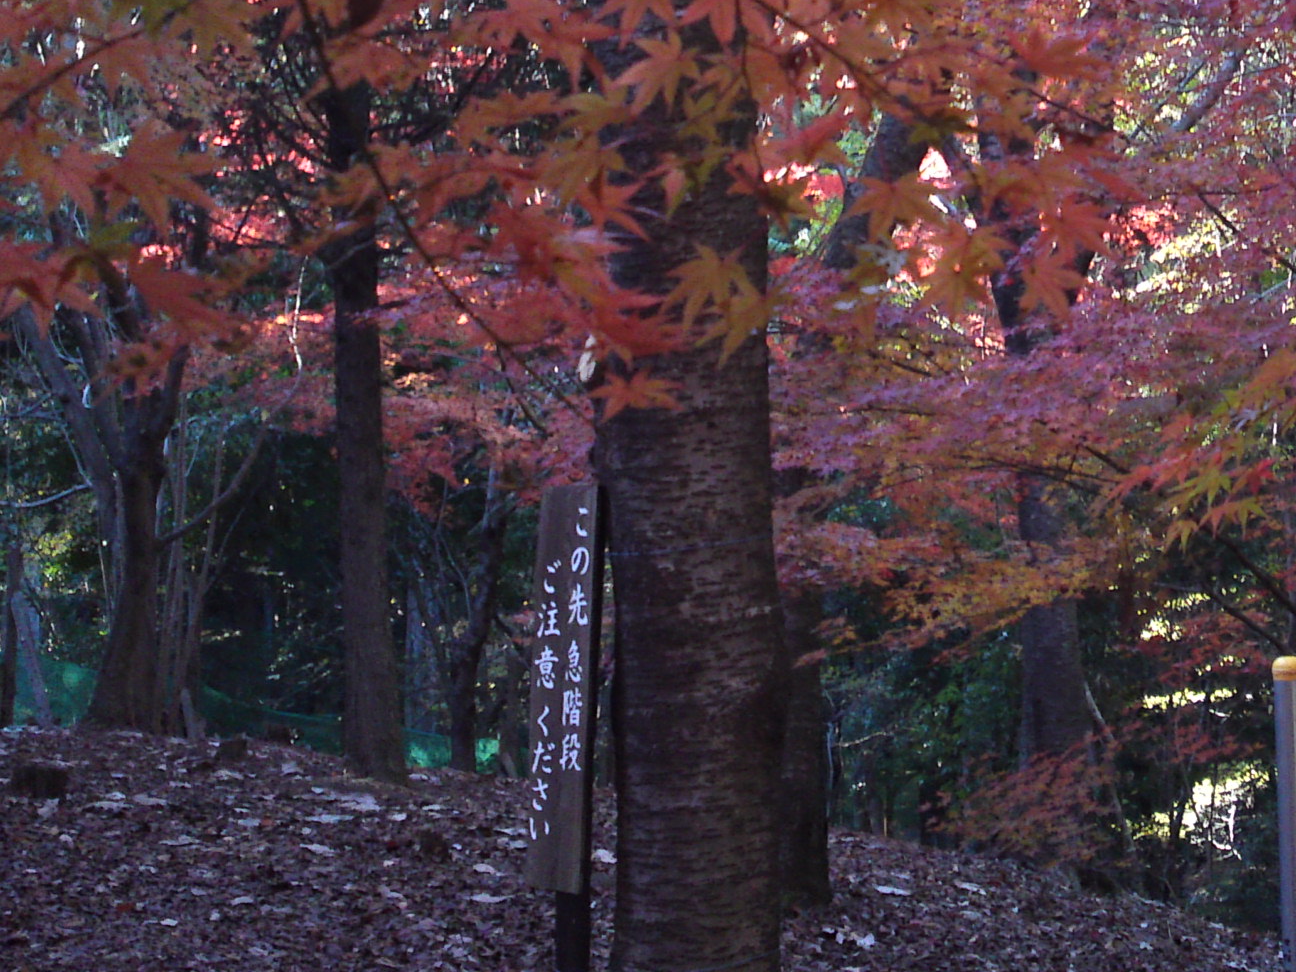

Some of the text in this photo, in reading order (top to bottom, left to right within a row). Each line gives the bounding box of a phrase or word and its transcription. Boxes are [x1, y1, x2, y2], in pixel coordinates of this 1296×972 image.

[530, 559, 562, 840] ご注意ください
[559, 507, 590, 771] この先急階段
